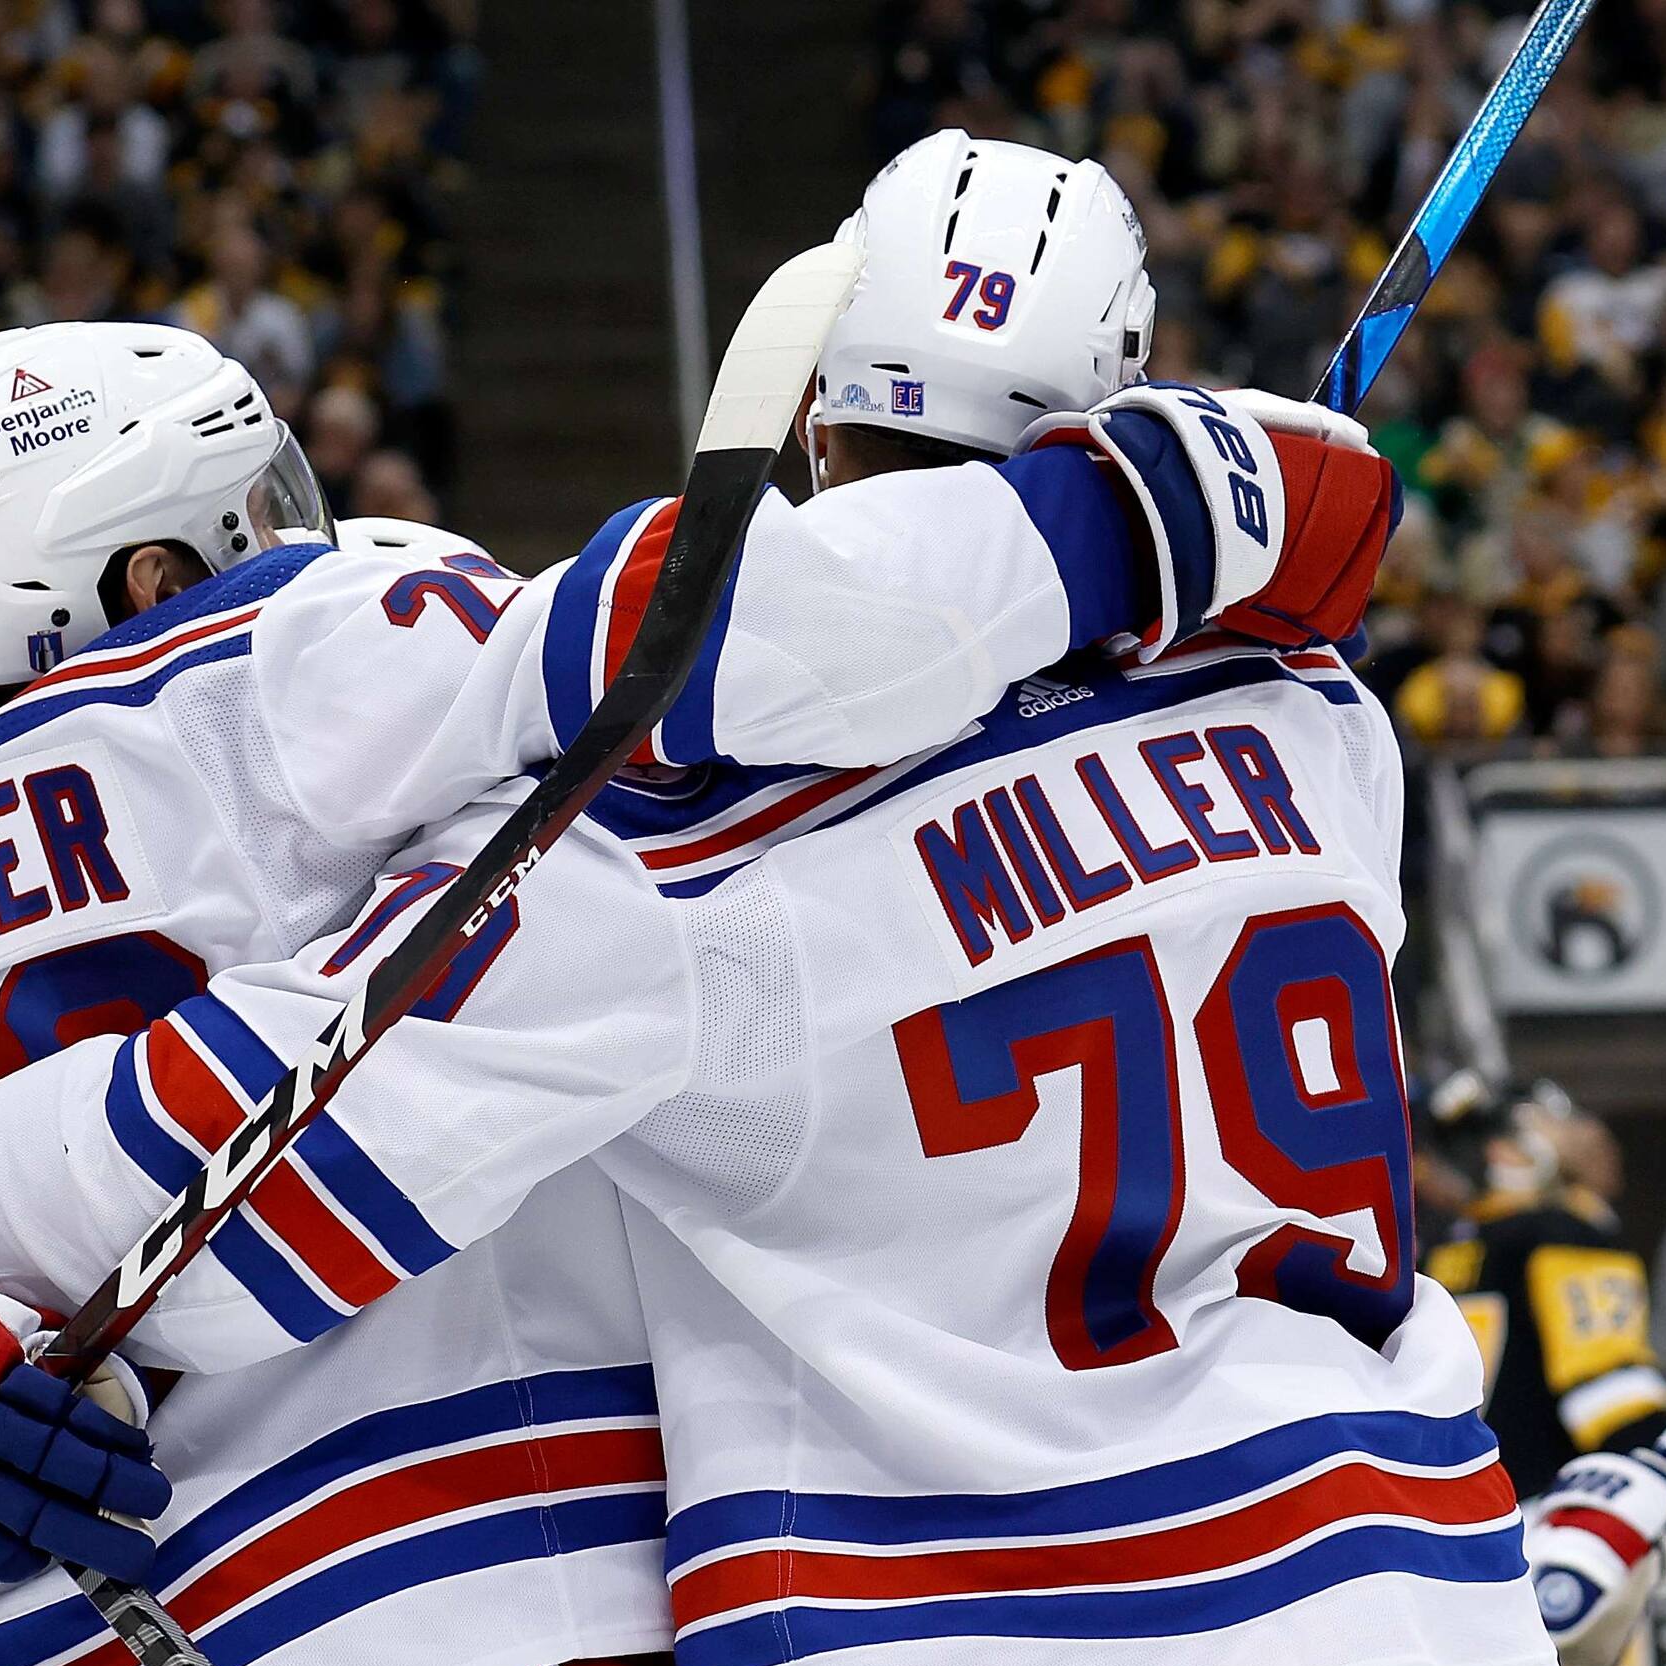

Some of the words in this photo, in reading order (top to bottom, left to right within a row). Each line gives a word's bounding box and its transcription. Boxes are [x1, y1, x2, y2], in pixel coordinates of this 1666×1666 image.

[942, 260, 1017, 331] 79
[9, 418, 91, 457] Moore
[1018, 685, 1095, 718] adidas
[459, 844, 541, 938] CCM
[914, 724, 1321, 968] MILLER
[117, 978, 369, 1308] CCM
[890, 900, 1416, 1373] 79
